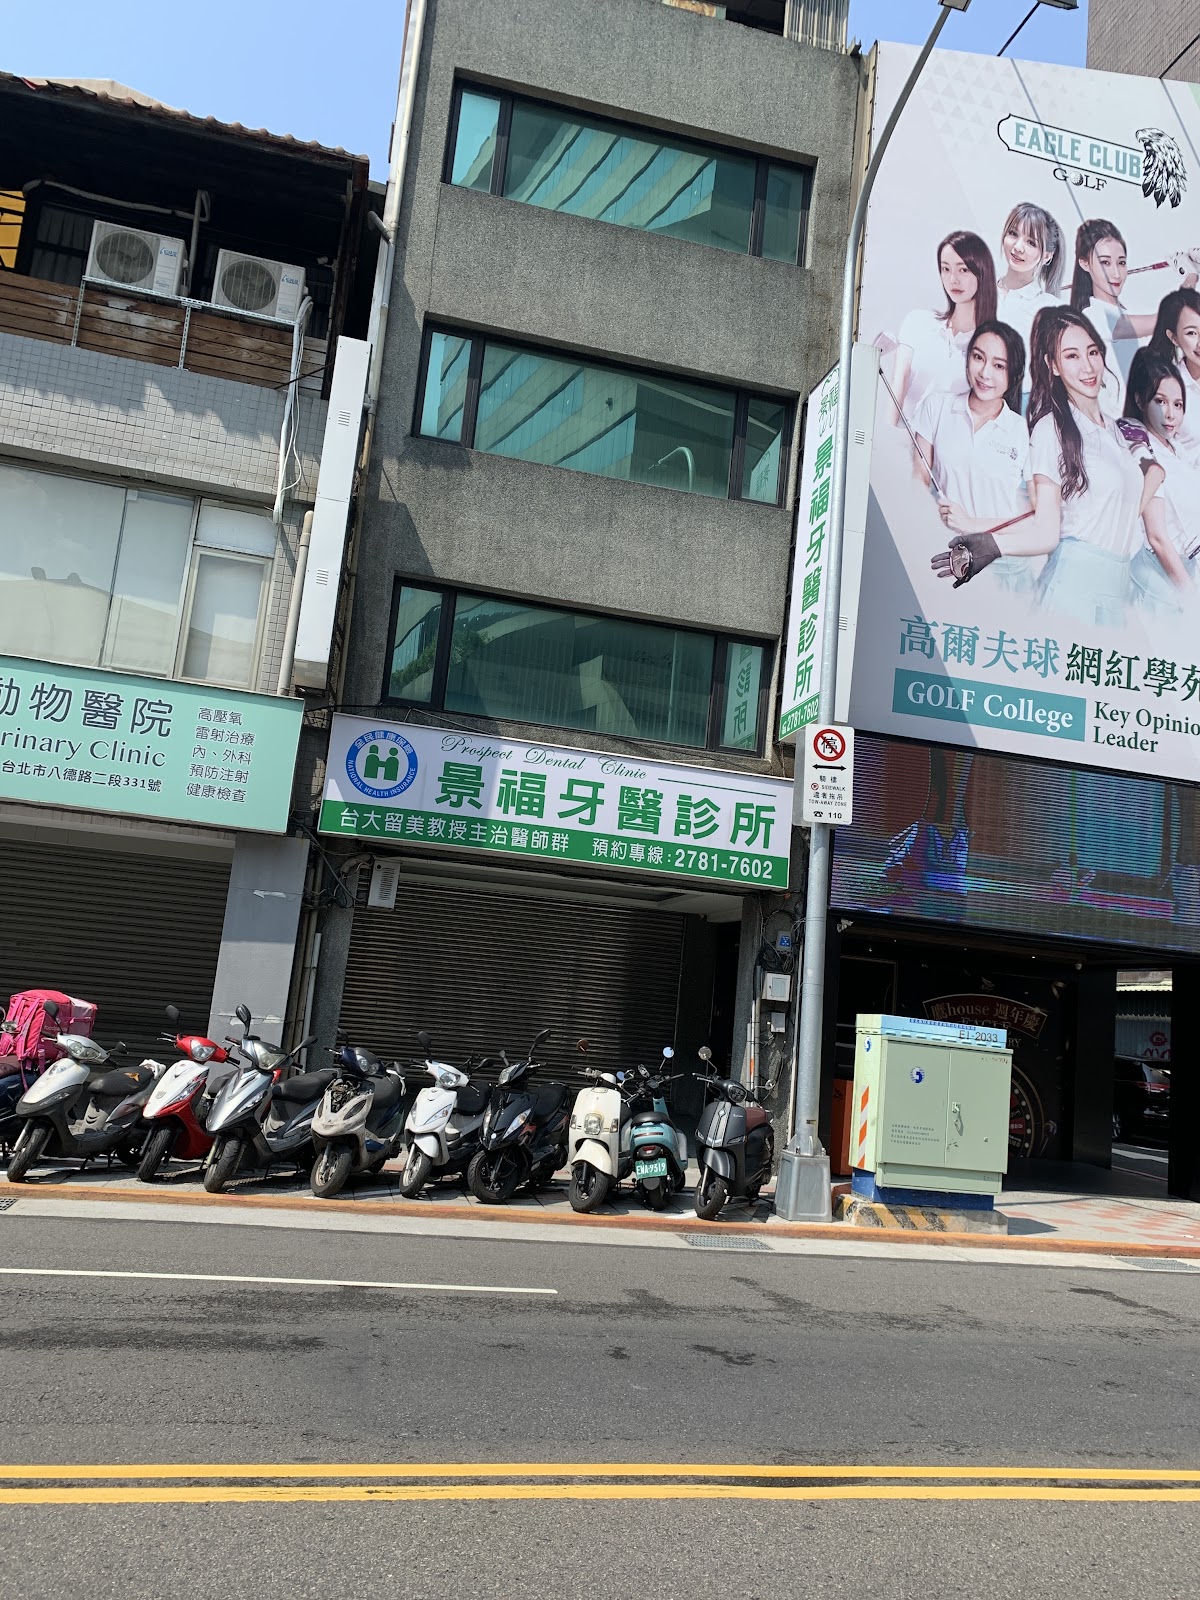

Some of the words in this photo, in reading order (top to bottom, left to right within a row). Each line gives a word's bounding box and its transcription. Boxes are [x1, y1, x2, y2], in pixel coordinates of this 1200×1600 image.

[1014, 122, 1082, 163] EAGLE
[1089, 142, 1142, 179] CLUB
[793, 434, 834, 701] 景福牙醫診所
[198, 707, 243, 726] 高壓氧
[907, 681, 976, 712] GOLF
[983, 694, 1074, 733] College
[1094, 701, 1131, 729] Key
[1, 727, 83, 761] rinary
[89, 740, 167, 767] Clinic
[195, 726, 256, 746] 雷射治療
[1093, 725, 1159, 753] Leader
[1, 759, 162, 793] 台北市八德路二段331號
[189, 763, 250, 784] 預防注射
[441, 734, 513, 763] Prospect
[522, 747, 587, 771] Dental
[597, 755, 648, 780] Clinic
[186, 783, 247, 803] 健康檢查
[347, 759, 364, 790] NATIONAL
[363, 786, 389, 797] HEALTH
[390, 767, 416, 796] INSURANCE
[434, 761, 776, 849] 景福牙醫診所
[340, 807, 569, 853] 台大留美教授主治醫師群
